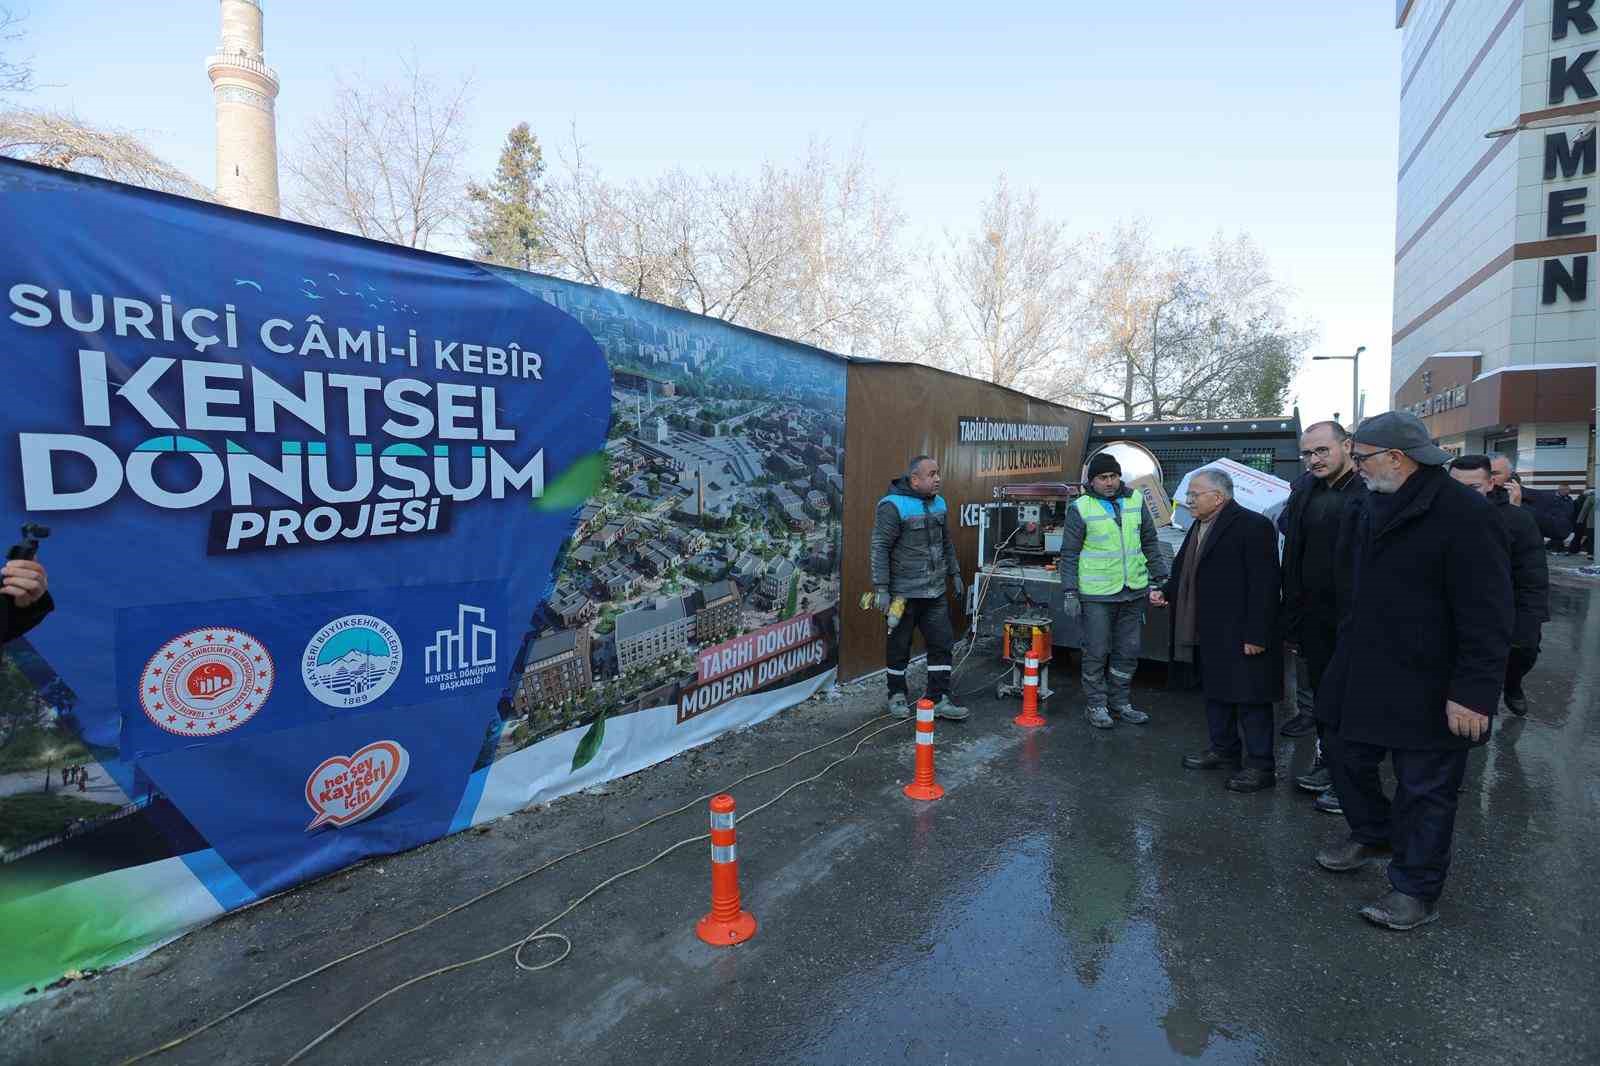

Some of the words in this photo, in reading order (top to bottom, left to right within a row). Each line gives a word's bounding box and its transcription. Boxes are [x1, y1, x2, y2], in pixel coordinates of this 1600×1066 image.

[9, 283, 238, 351] SURİÇİ
[434, 342, 543, 380] KEBÎR
[79, 349, 516, 440] KENTSEL
[226, 497, 440, 550] PROJESİ
[425, 672, 458, 684] KENTSEL
[681, 668, 755, 719] MODERN
[758, 638, 825, 684] DOKUNUŞ
[701, 638, 753, 680] TARİHİ
[756, 617, 812, 658] DOKUYA
